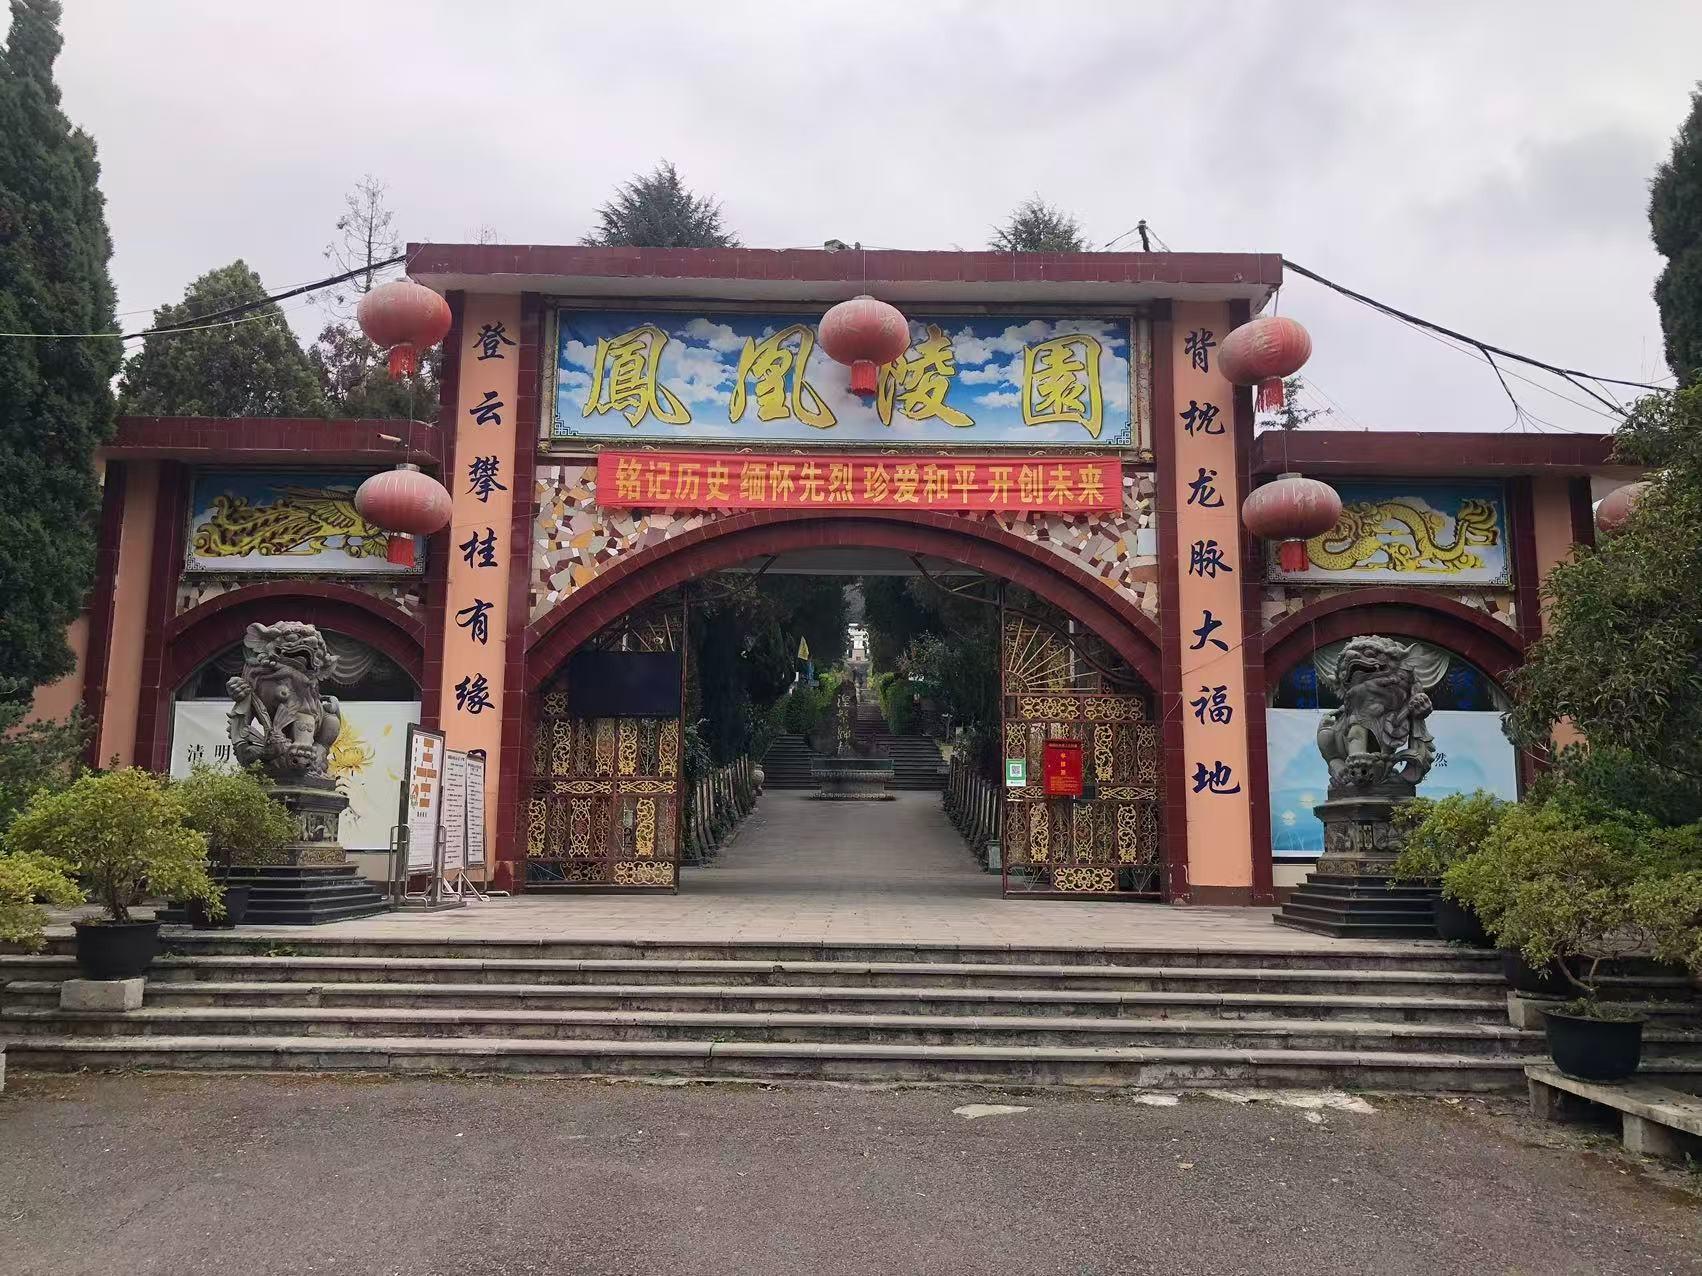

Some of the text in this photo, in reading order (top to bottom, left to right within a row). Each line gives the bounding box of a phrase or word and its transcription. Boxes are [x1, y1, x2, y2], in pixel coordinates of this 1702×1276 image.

[454, 321, 517, 762] 登云攀桂有缘
[615, 458, 1104, 506] 铭记历史 缅怀先烈 珍爱和平 开创未来
[1179, 328, 1241, 796] 背枕龙脉大福地
[187, 744, 231, 764] 清明
